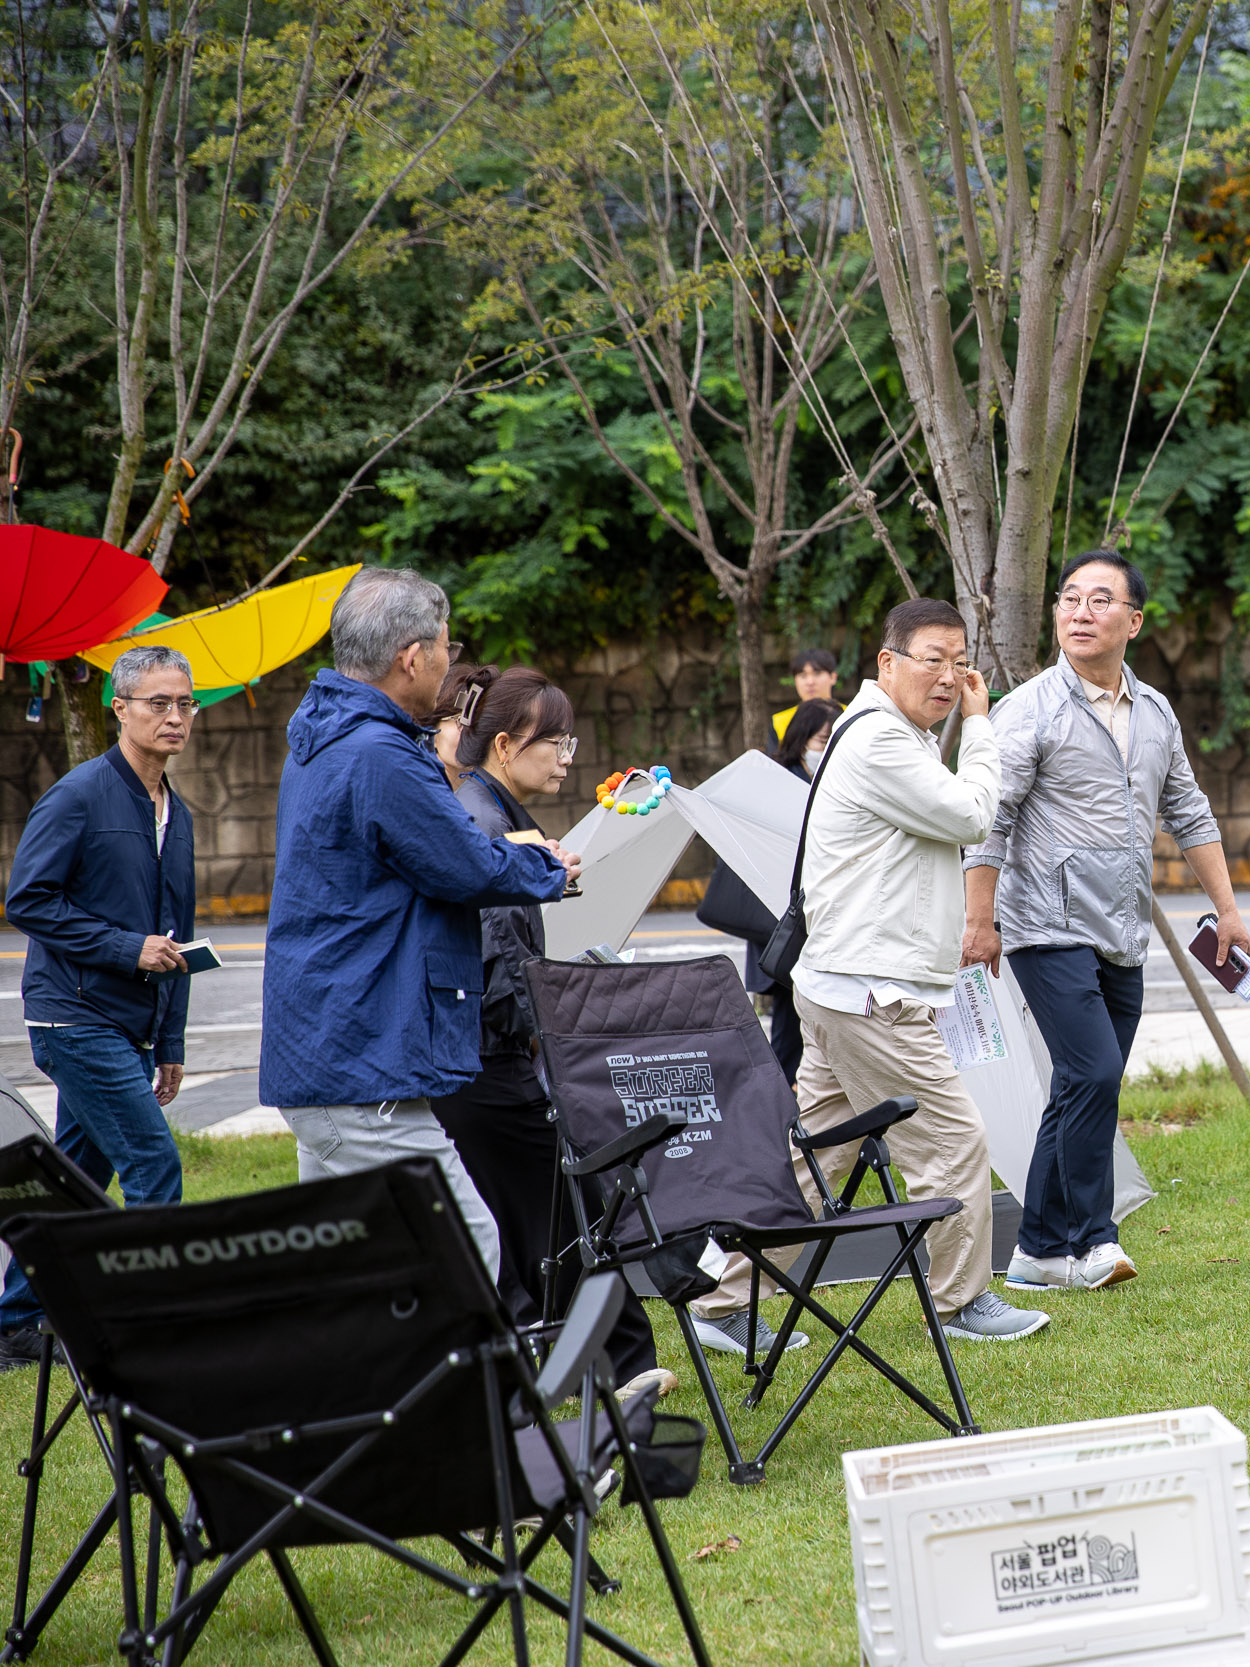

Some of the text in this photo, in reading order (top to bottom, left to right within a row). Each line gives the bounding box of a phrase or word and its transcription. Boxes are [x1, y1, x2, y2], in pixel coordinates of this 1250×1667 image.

[610, 1056, 631, 1065] new
[610, 1063, 715, 1098] SURFER
[682, 1129, 712, 1142] KZM
[669, 1147, 689, 1157] 2008
[97, 1219, 369, 1274] KZM OUTDOOR
[1000, 1534, 1078, 1572] 서울 팝업
[1001, 1565, 1085, 1593] 야외도서관
[997, 1584, 1139, 1613] Seoul POP-UP Outdoor Library
